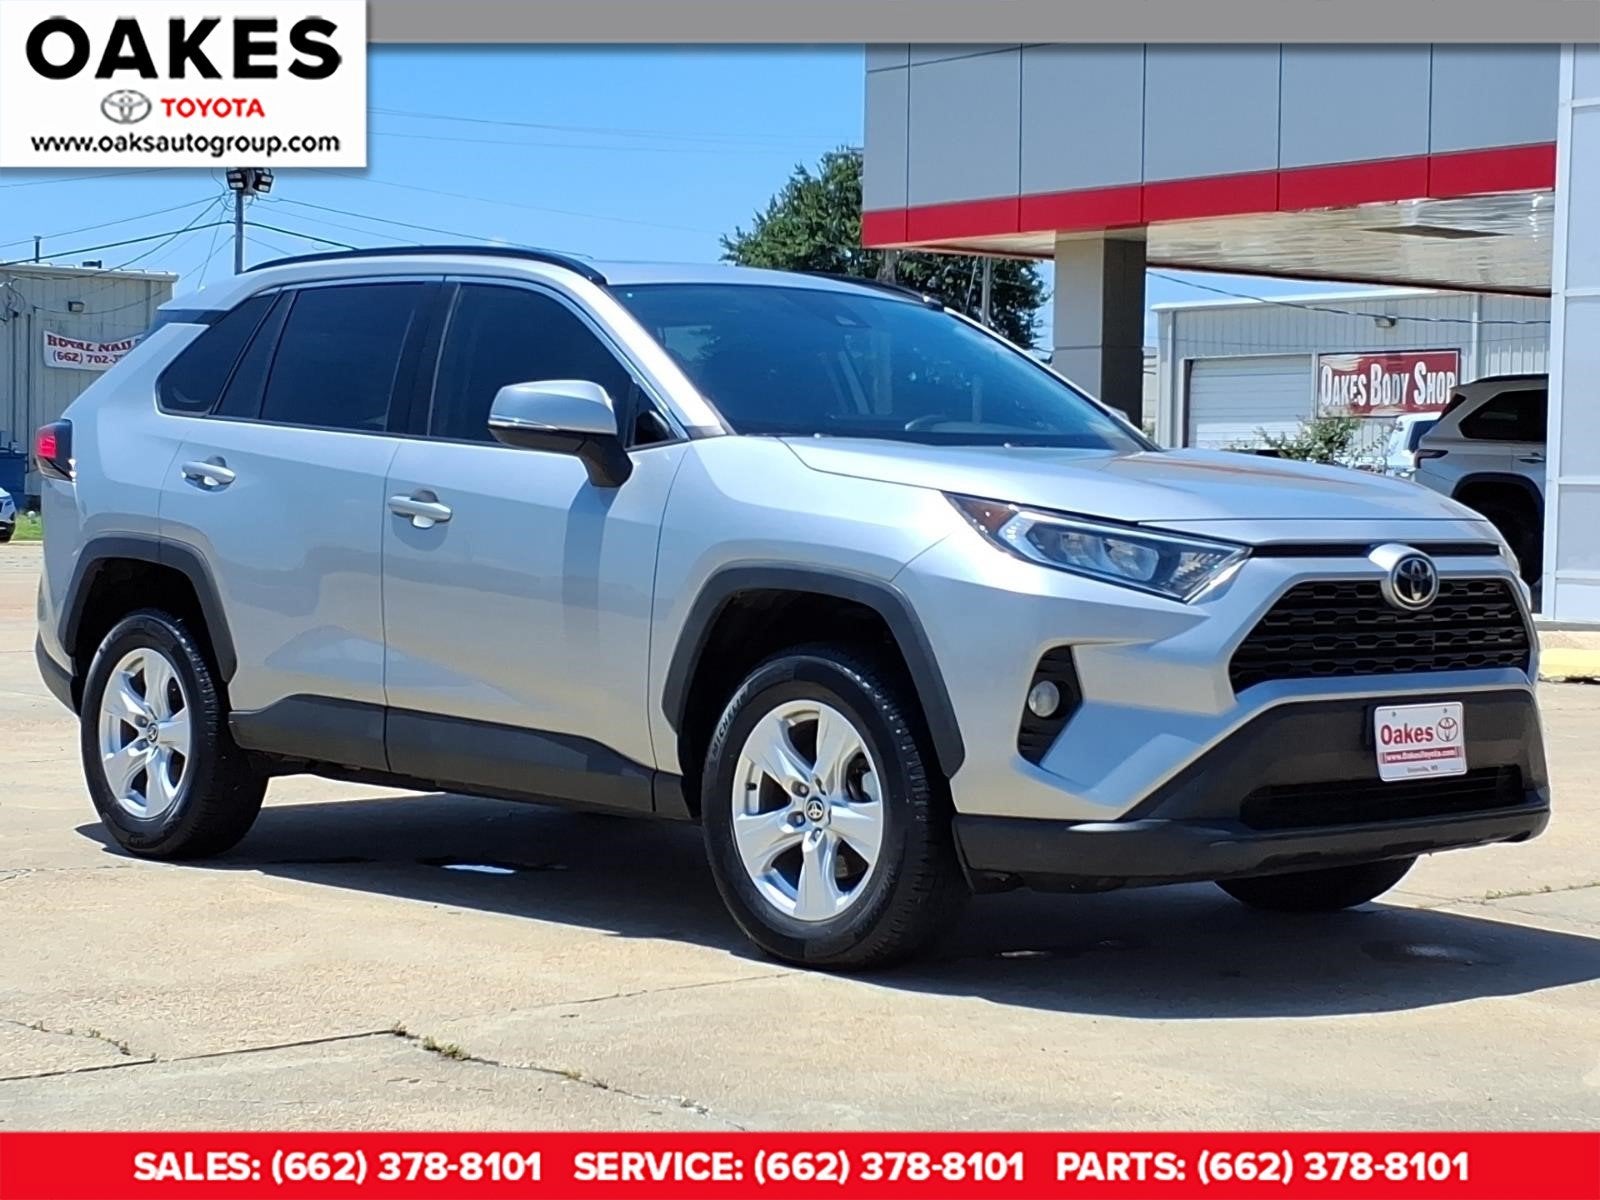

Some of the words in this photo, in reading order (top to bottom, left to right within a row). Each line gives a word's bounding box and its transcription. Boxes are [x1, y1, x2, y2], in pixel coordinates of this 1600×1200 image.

[47, 335, 94, 352] ROYAL
[53, 350, 83, 365] (662)
[1321, 365, 1367, 406] OAKES
[1370, 363, 1410, 405] BODY
[1413, 361, 1456, 405] SHOP
[1380, 722, 1434, 746] Oakes
